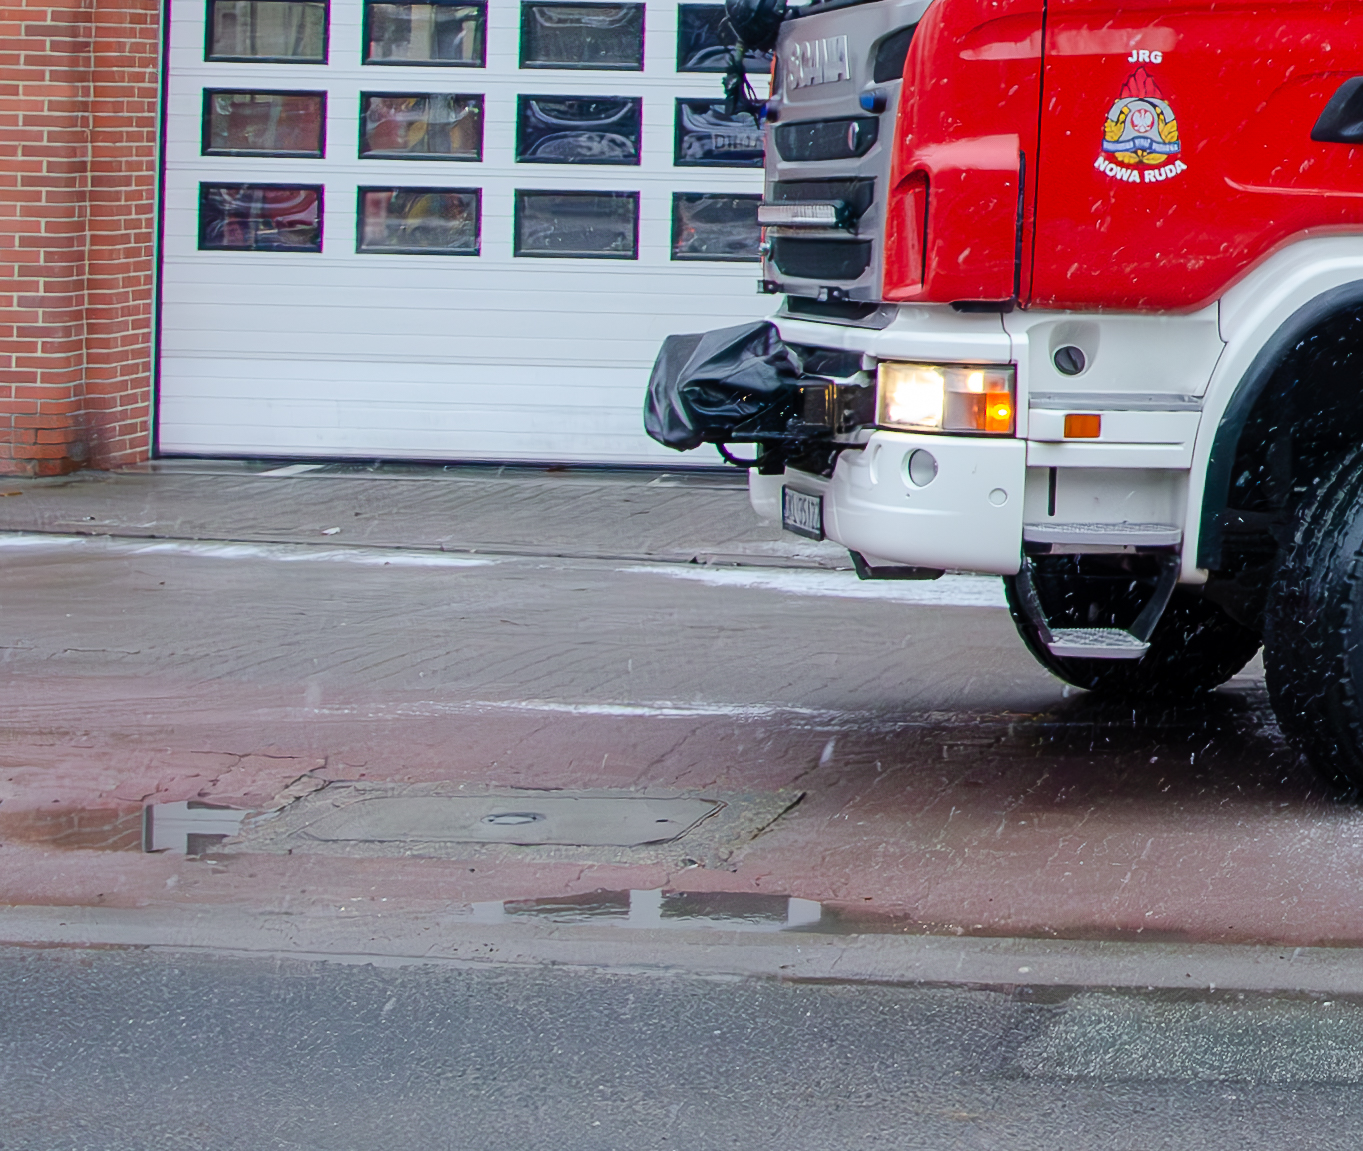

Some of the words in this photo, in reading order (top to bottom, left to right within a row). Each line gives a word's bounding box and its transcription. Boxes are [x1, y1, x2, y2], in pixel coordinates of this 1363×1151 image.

[1127, 49, 1163, 64] JRG
[1093, 155, 1141, 184] NOWA
[1143, 159, 1188, 184] RUDA
